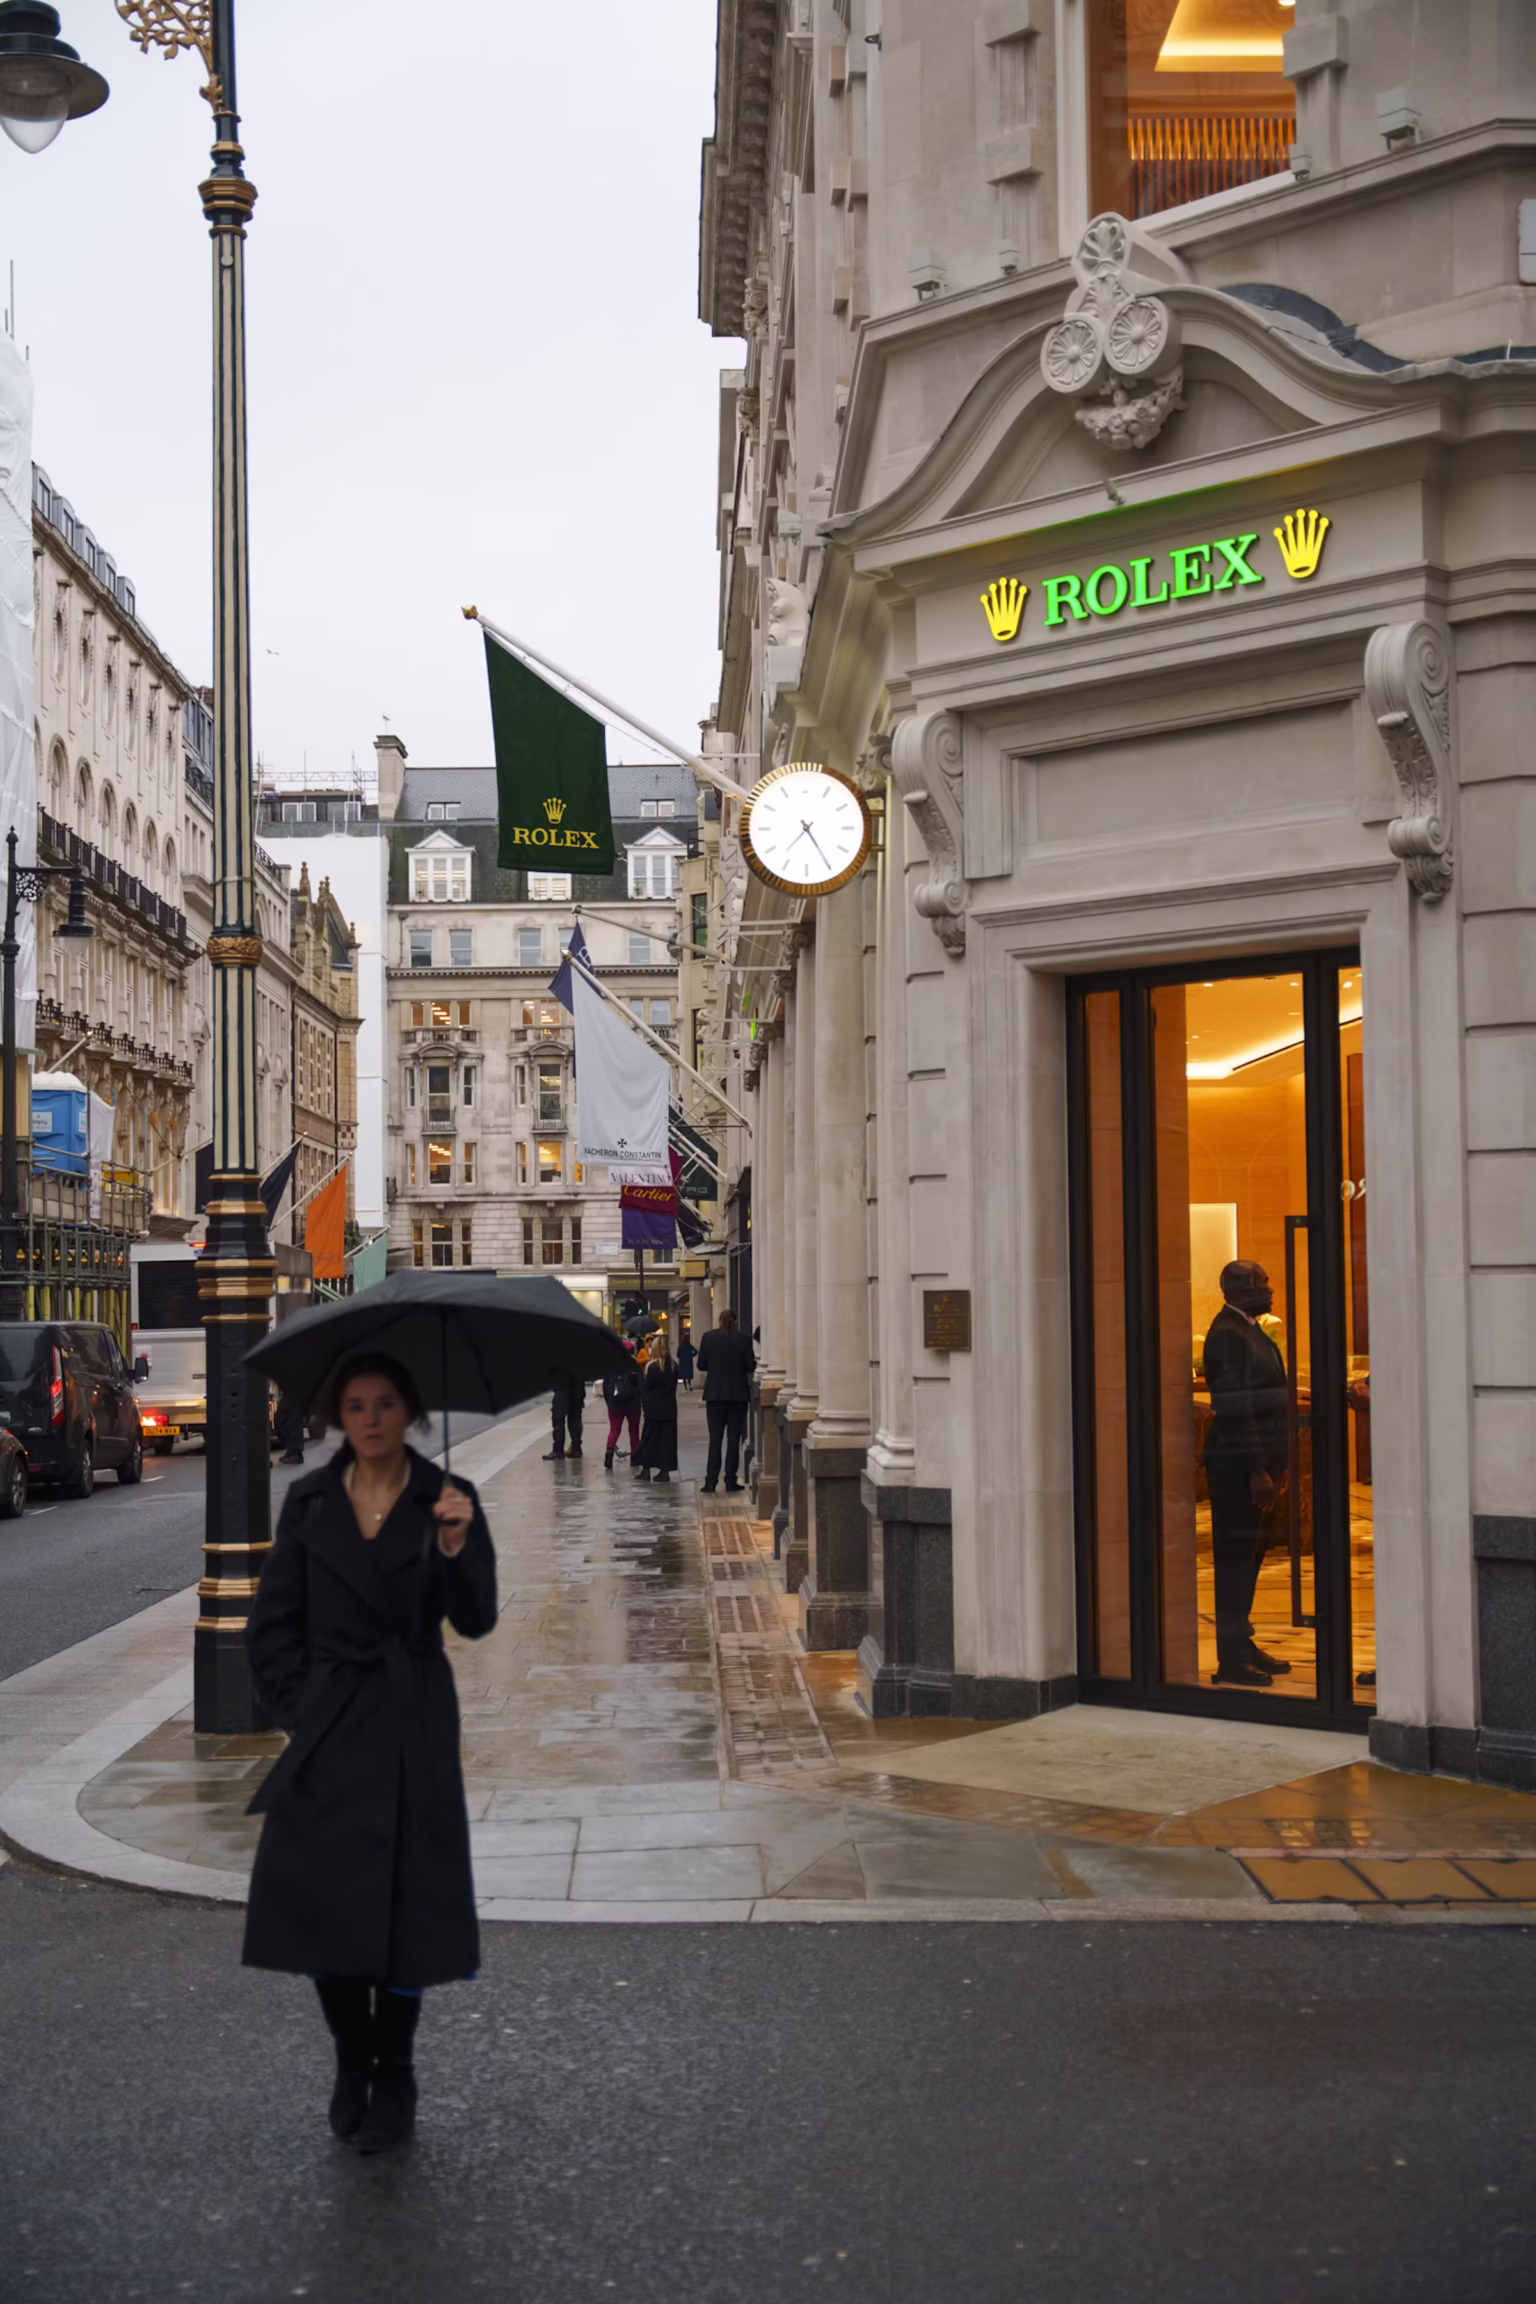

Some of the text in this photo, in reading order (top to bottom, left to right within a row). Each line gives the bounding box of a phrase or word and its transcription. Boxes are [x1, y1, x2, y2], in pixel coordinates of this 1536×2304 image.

[1041, 533, 1263, 626] ROLEX
[512, 827, 600, 849] ROLEX
[583, 1147, 662, 1159] VACHERON CONSTANTIN
[611, 1172, 671, 1184] VALENTINO
[623, 1184, 676, 1202] Cartier
